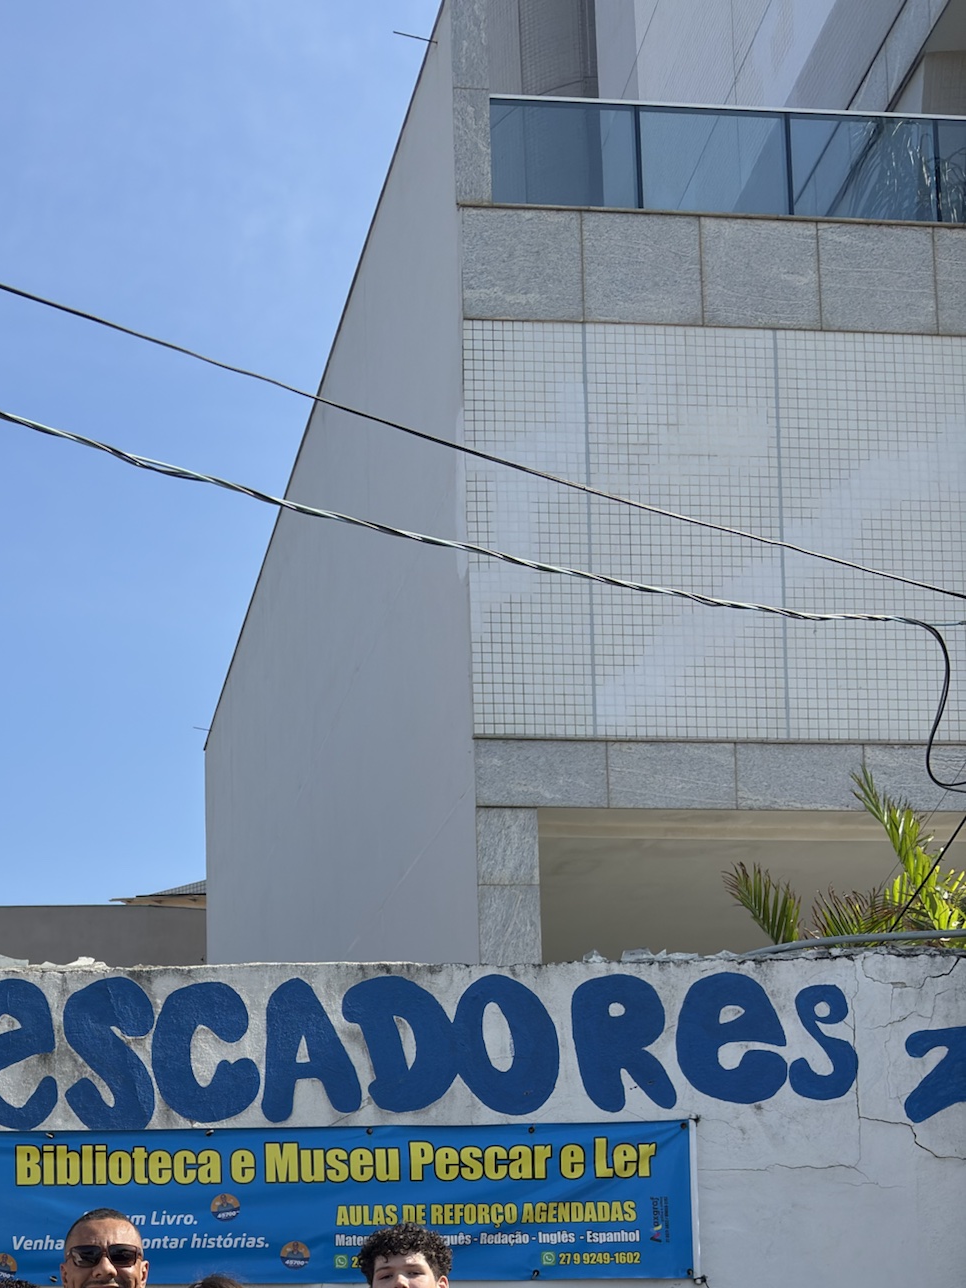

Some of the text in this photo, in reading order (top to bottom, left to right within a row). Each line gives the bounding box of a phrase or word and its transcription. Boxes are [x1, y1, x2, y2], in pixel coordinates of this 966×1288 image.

[15, 1136, 656, 1186] Biblioteca e Museu Pescar e Ler
[151, 1210, 198, 1226] Livro.
[336, 1203, 398, 1226] AULAS
[402, 1204, 427, 1225] DE
[430, 1203, 518, 1228] REFORÇO
[521, 1201, 637, 1224] AGENDADAS
[12, 1235, 65, 1250] Venha
[191, 1232, 269, 1250] histórias.
[480, 1231, 529, 1246] Redação
[538, 1231, 576, 1245] Inglês
[586, 1229, 640, 1244] Espanhol
[558, 1251, 641, 1264] 27 9 9249-1602
